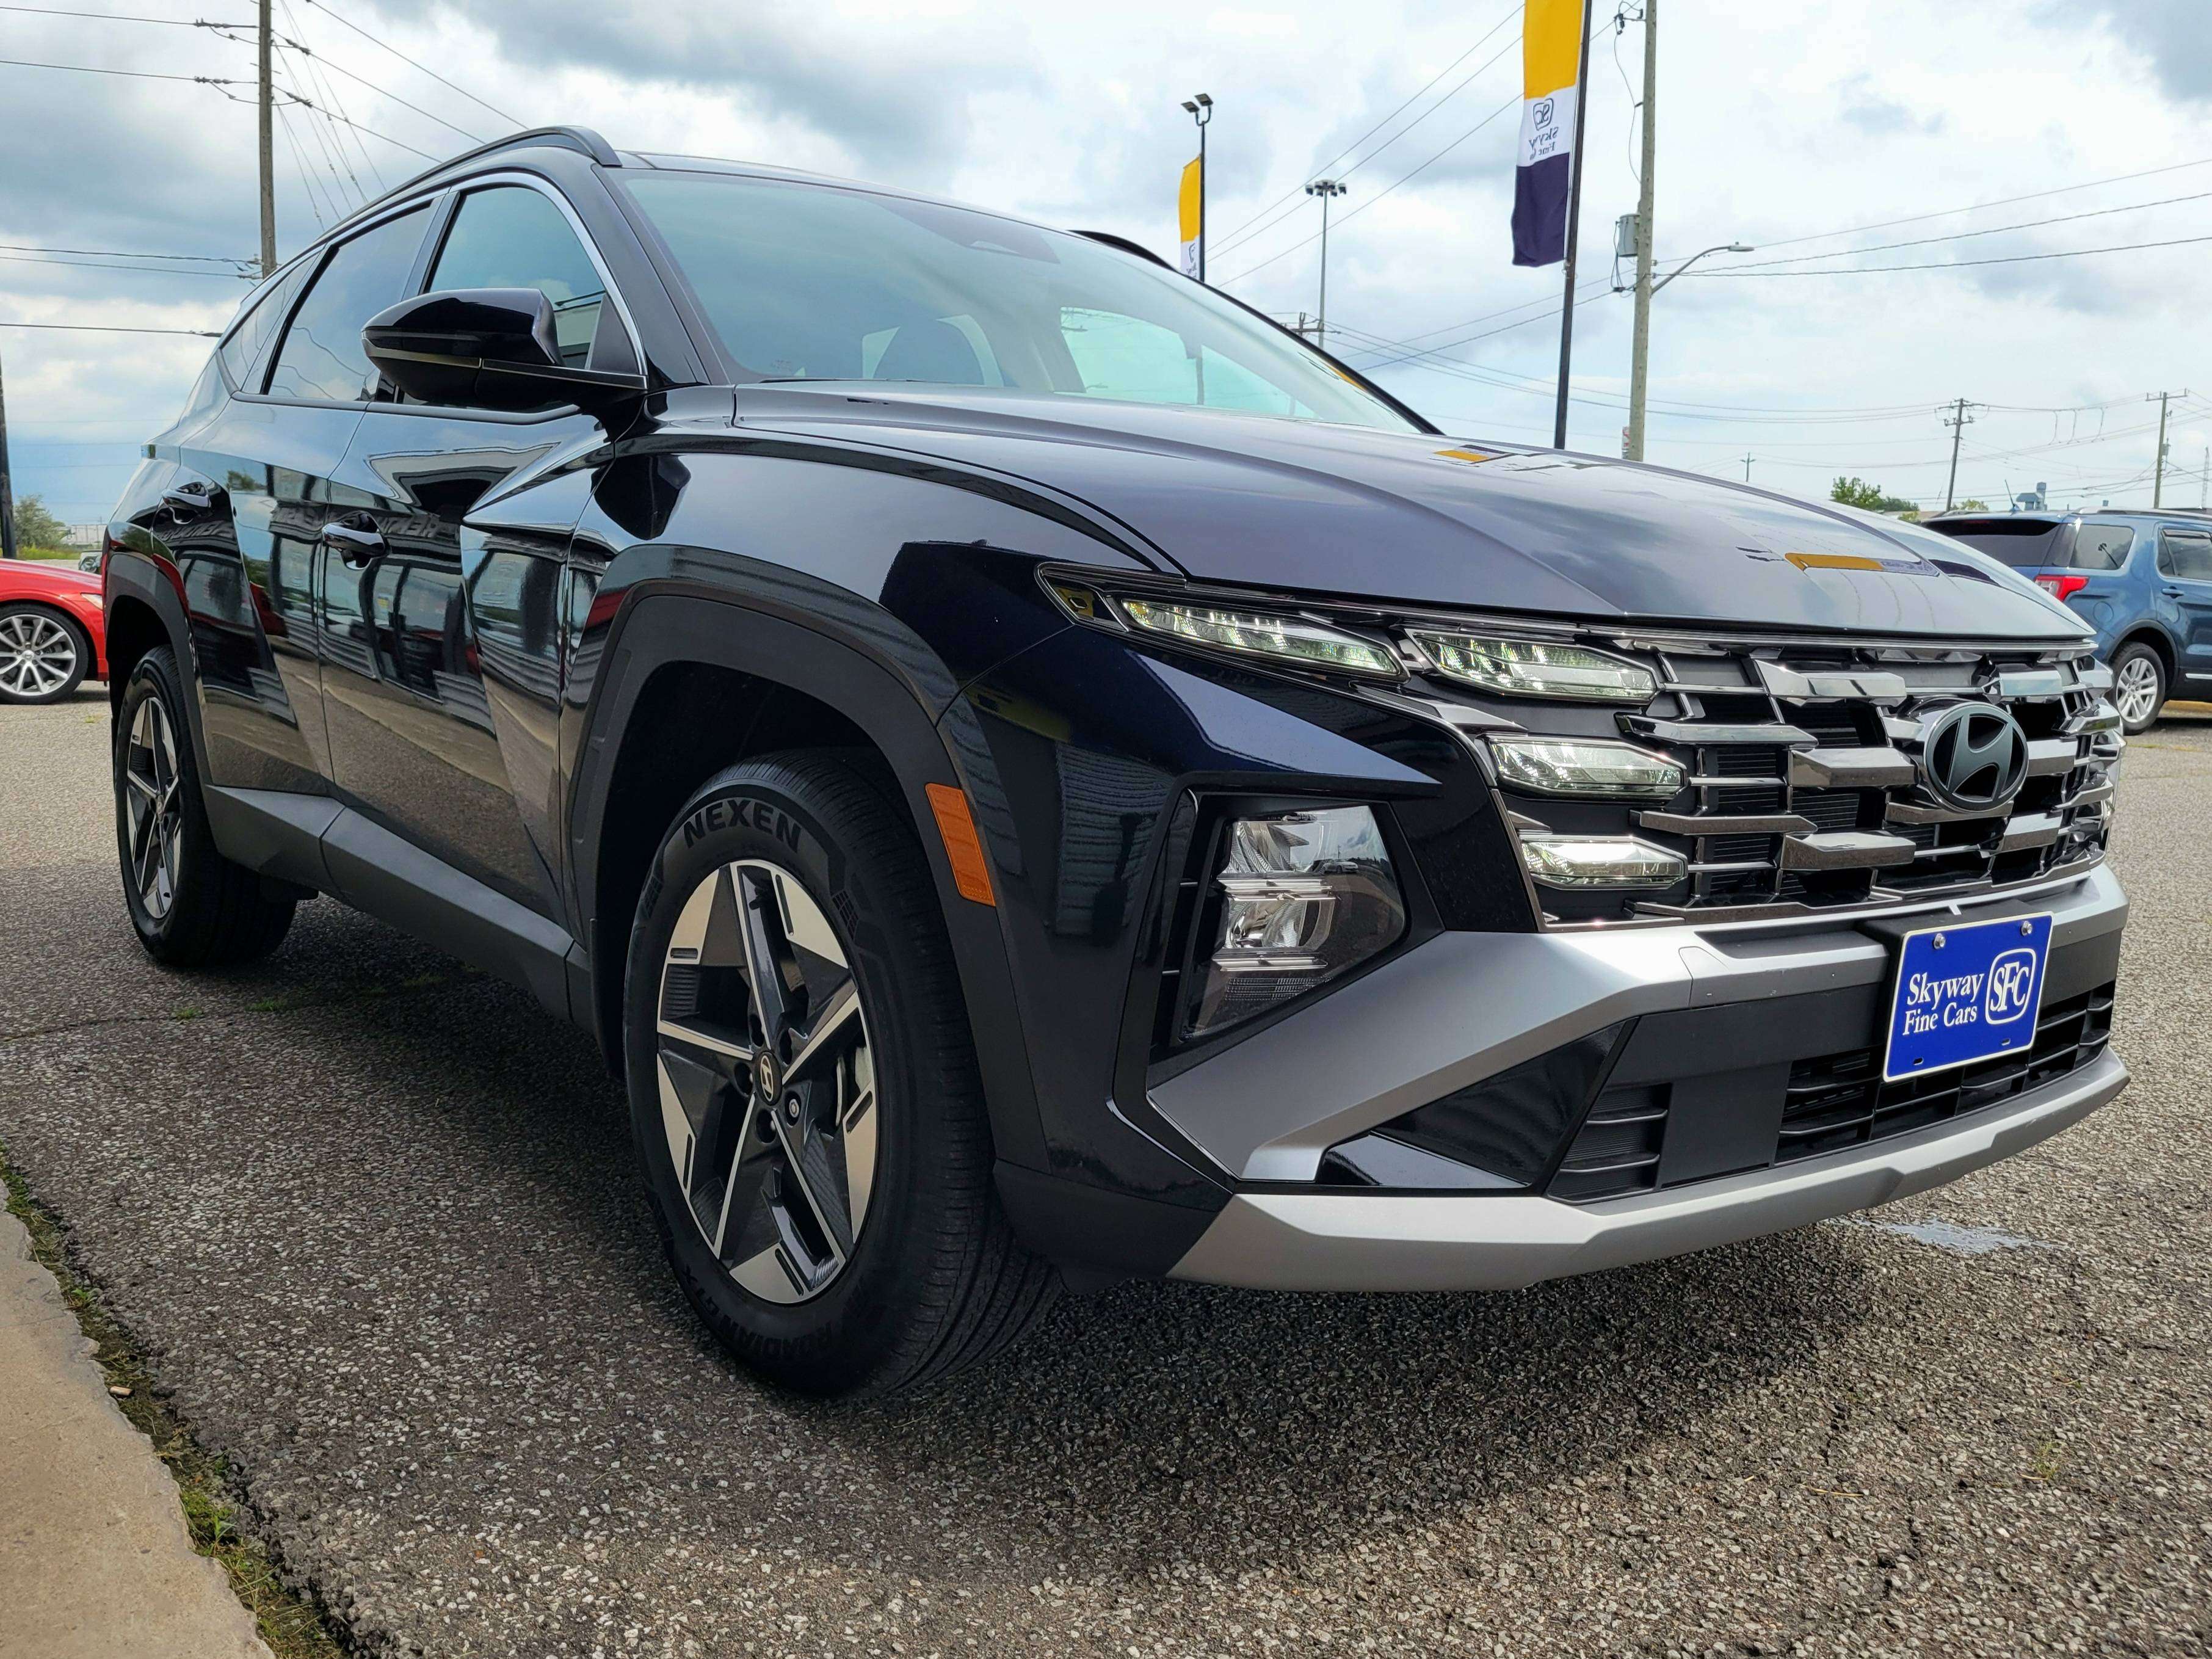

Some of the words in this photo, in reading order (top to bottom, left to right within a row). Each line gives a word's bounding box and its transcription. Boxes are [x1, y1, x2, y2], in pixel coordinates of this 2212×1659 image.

[683, 798, 802, 853] NEXEN
[1907, 971, 1984, 1011] Skyway
[1990, 961, 2029, 1012] SFC
[1902, 1009, 1938, 1036] Fine
[1943, 1002, 1978, 1027] Cars
